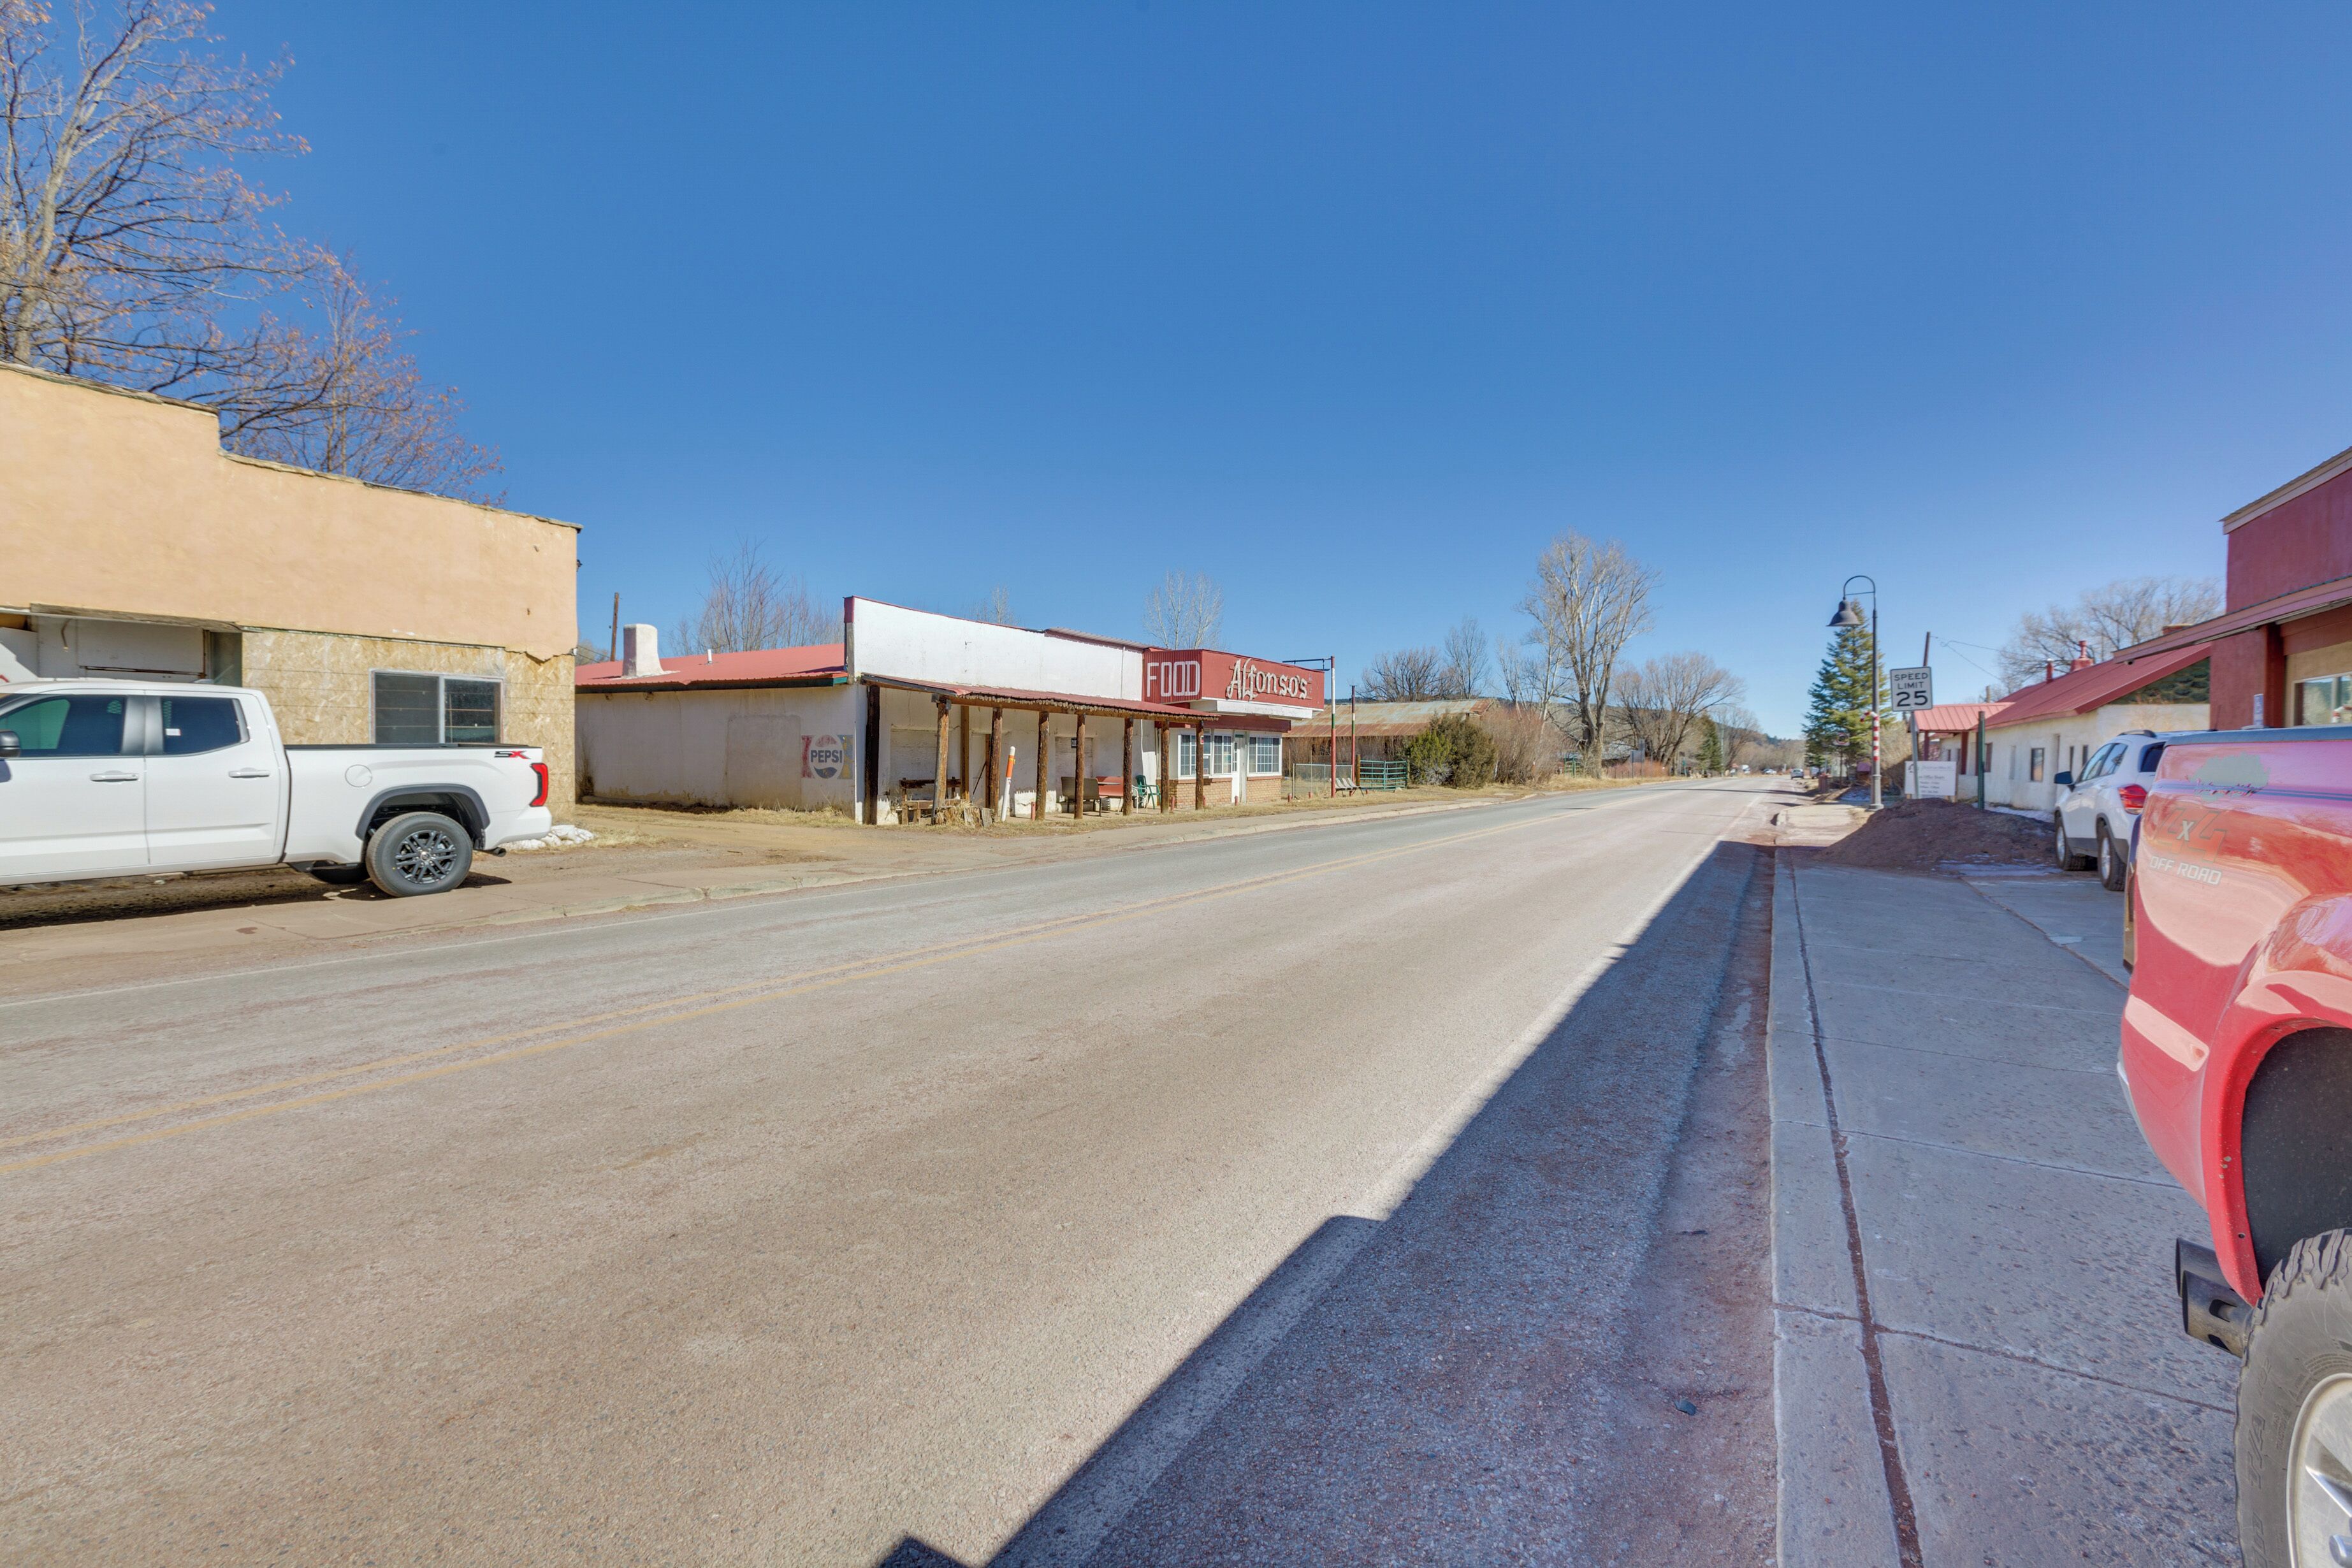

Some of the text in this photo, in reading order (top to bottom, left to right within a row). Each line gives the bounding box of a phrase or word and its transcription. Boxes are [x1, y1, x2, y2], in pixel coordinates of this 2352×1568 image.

[1147, 660, 1200, 697] FOOD
[1226, 658, 1308, 701] Alfonso's
[1894, 672, 1928, 681] SPEED
[1898, 681, 1924, 690] LIMIT
[1896, 690, 1928, 707] 25
[810, 749, 843, 764] PEPSI
[2150, 856, 2222, 885] OFF ROAD
